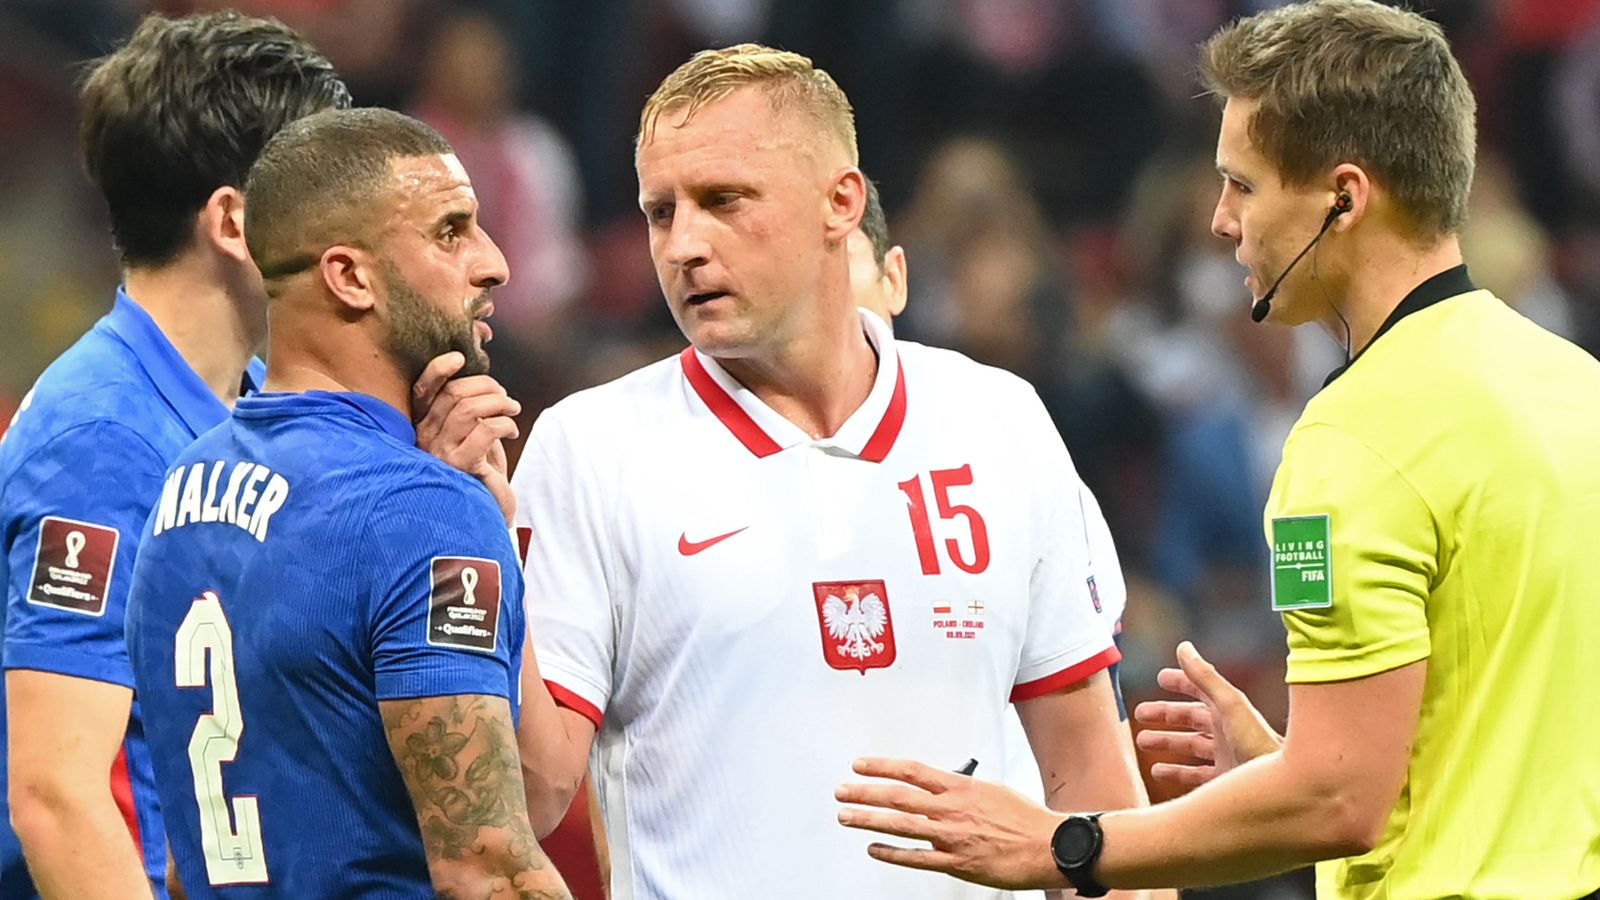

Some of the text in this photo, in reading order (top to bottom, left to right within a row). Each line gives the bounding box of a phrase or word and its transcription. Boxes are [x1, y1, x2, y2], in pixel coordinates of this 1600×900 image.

[898, 463, 990, 575] 15
[1275, 540, 1324, 552] LIVING
[1275, 550, 1325, 562] FOOTBALL
[1302, 570, 1325, 582] FIFA
[443, 623, 488, 637] Qualifiers
[175, 590, 269, 885] 2
